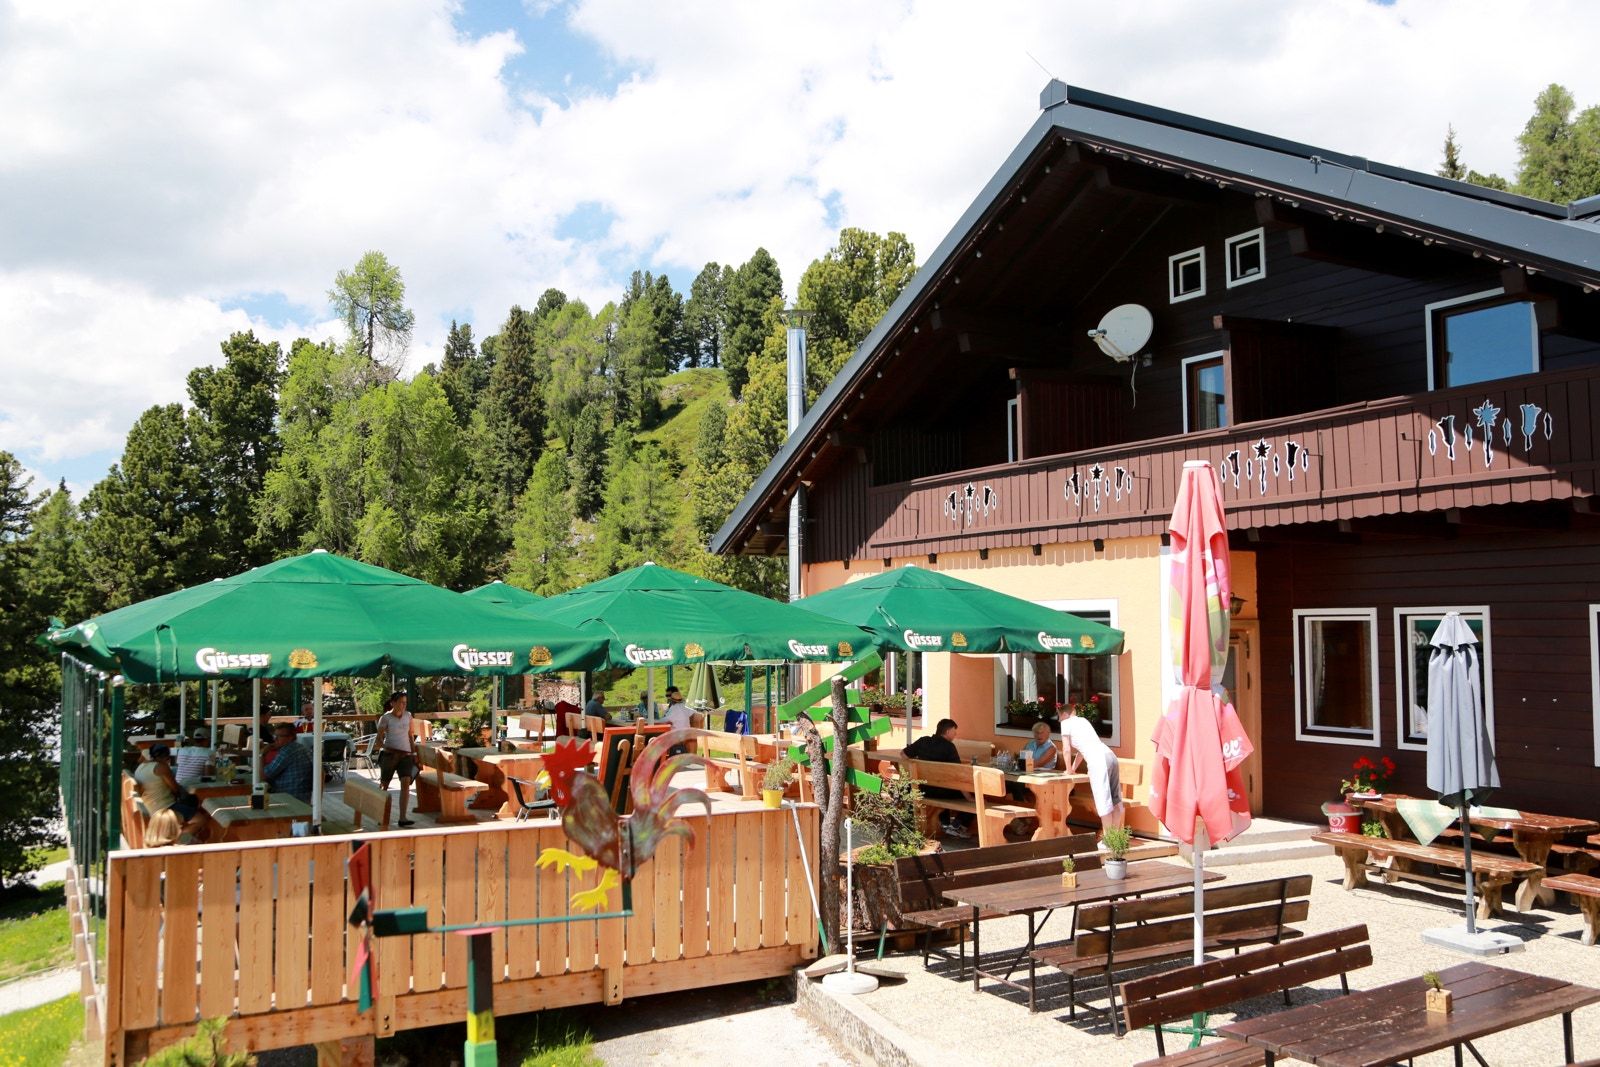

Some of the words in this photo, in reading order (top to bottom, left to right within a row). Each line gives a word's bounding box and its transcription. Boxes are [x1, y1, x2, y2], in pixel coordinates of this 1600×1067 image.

[787, 639, 829, 658] Gösser
[903, 629, 942, 649] Gösser
[1037, 631, 1073, 650] Gösser
[195, 647, 270, 673] Gösser
[452, 644, 514, 671] Gösser
[625, 643, 674, 666] Gösser
